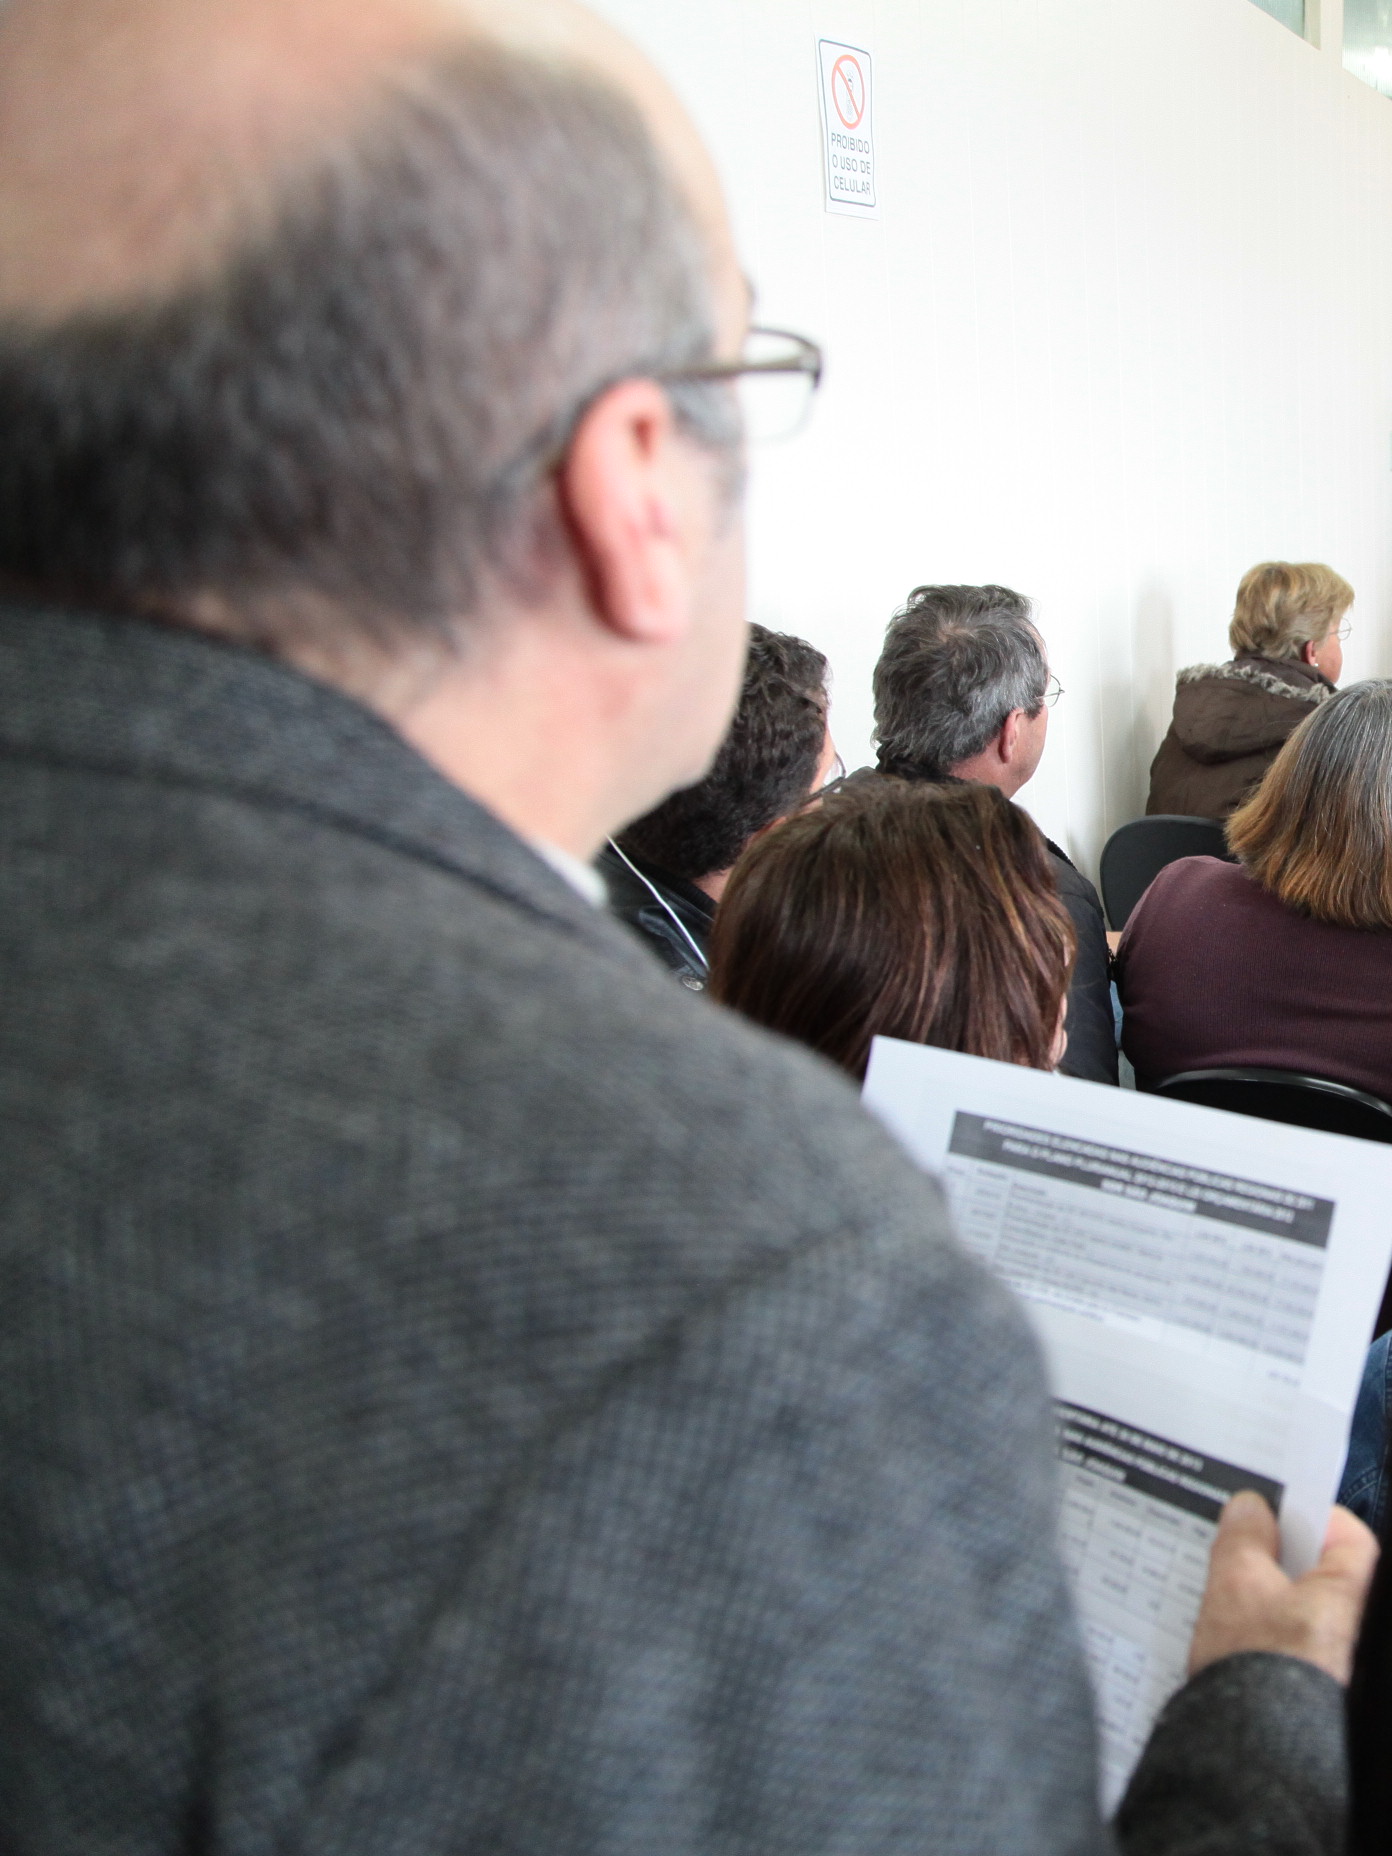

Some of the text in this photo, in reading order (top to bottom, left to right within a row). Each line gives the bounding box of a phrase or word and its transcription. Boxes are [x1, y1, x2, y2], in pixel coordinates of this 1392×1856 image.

[831, 132, 869, 153] PROIBIDO
[832, 154, 871, 175] O USO DE
[834, 175, 870, 195] CELULAR
